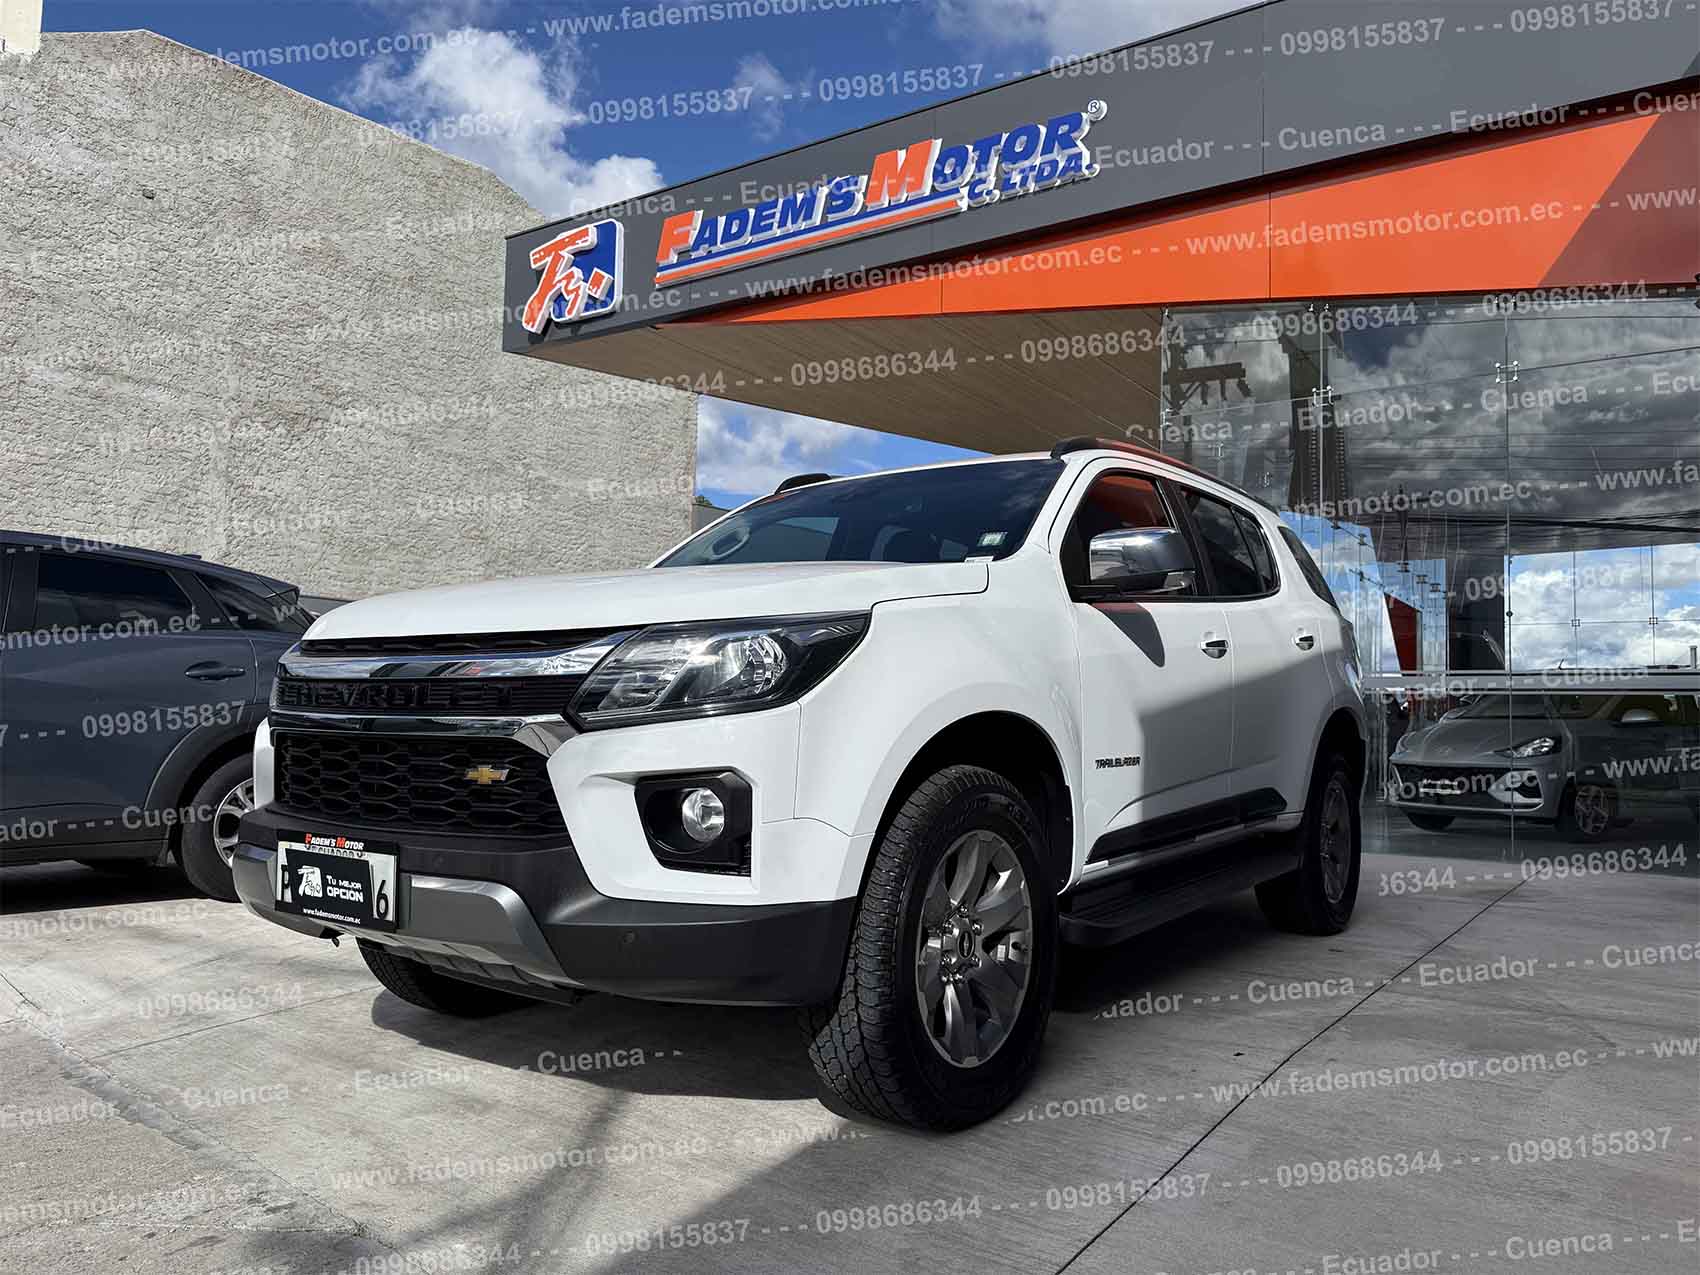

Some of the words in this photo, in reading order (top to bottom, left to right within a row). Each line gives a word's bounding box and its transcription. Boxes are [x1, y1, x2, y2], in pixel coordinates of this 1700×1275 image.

[864, 111, 1091, 207] MOTOR
[336, 836, 364, 850] MOTOR
[376, 879, 389, 920] 6
